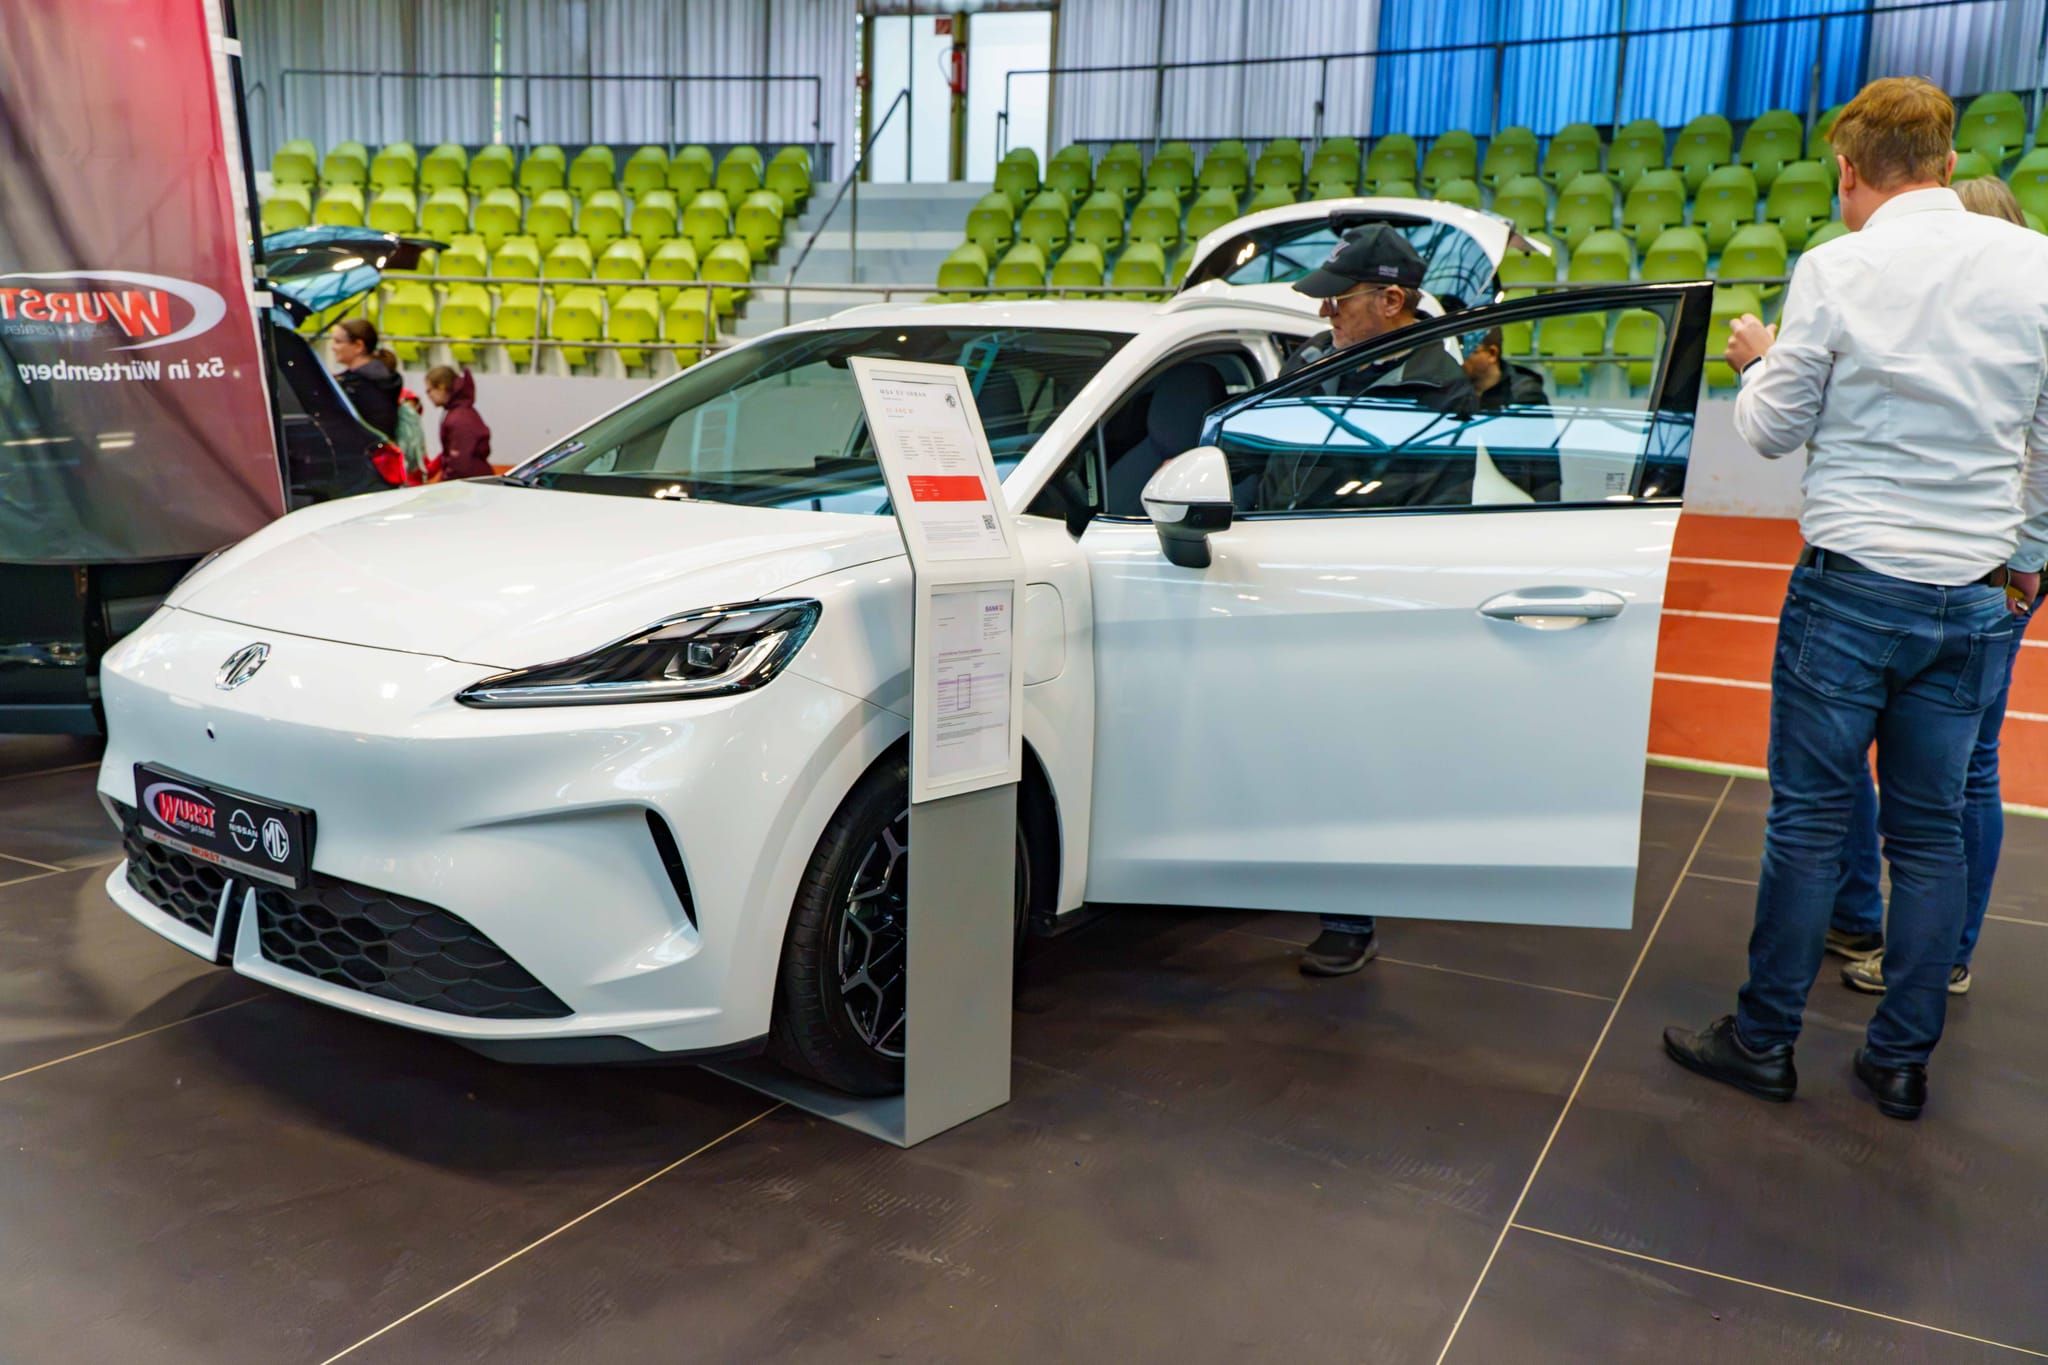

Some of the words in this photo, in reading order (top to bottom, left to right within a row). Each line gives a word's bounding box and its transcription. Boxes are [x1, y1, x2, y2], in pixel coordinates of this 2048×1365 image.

[158, 792, 216, 829] WURST
[229, 823, 258, 839] NISSAN
[264, 821, 287, 860] MG
